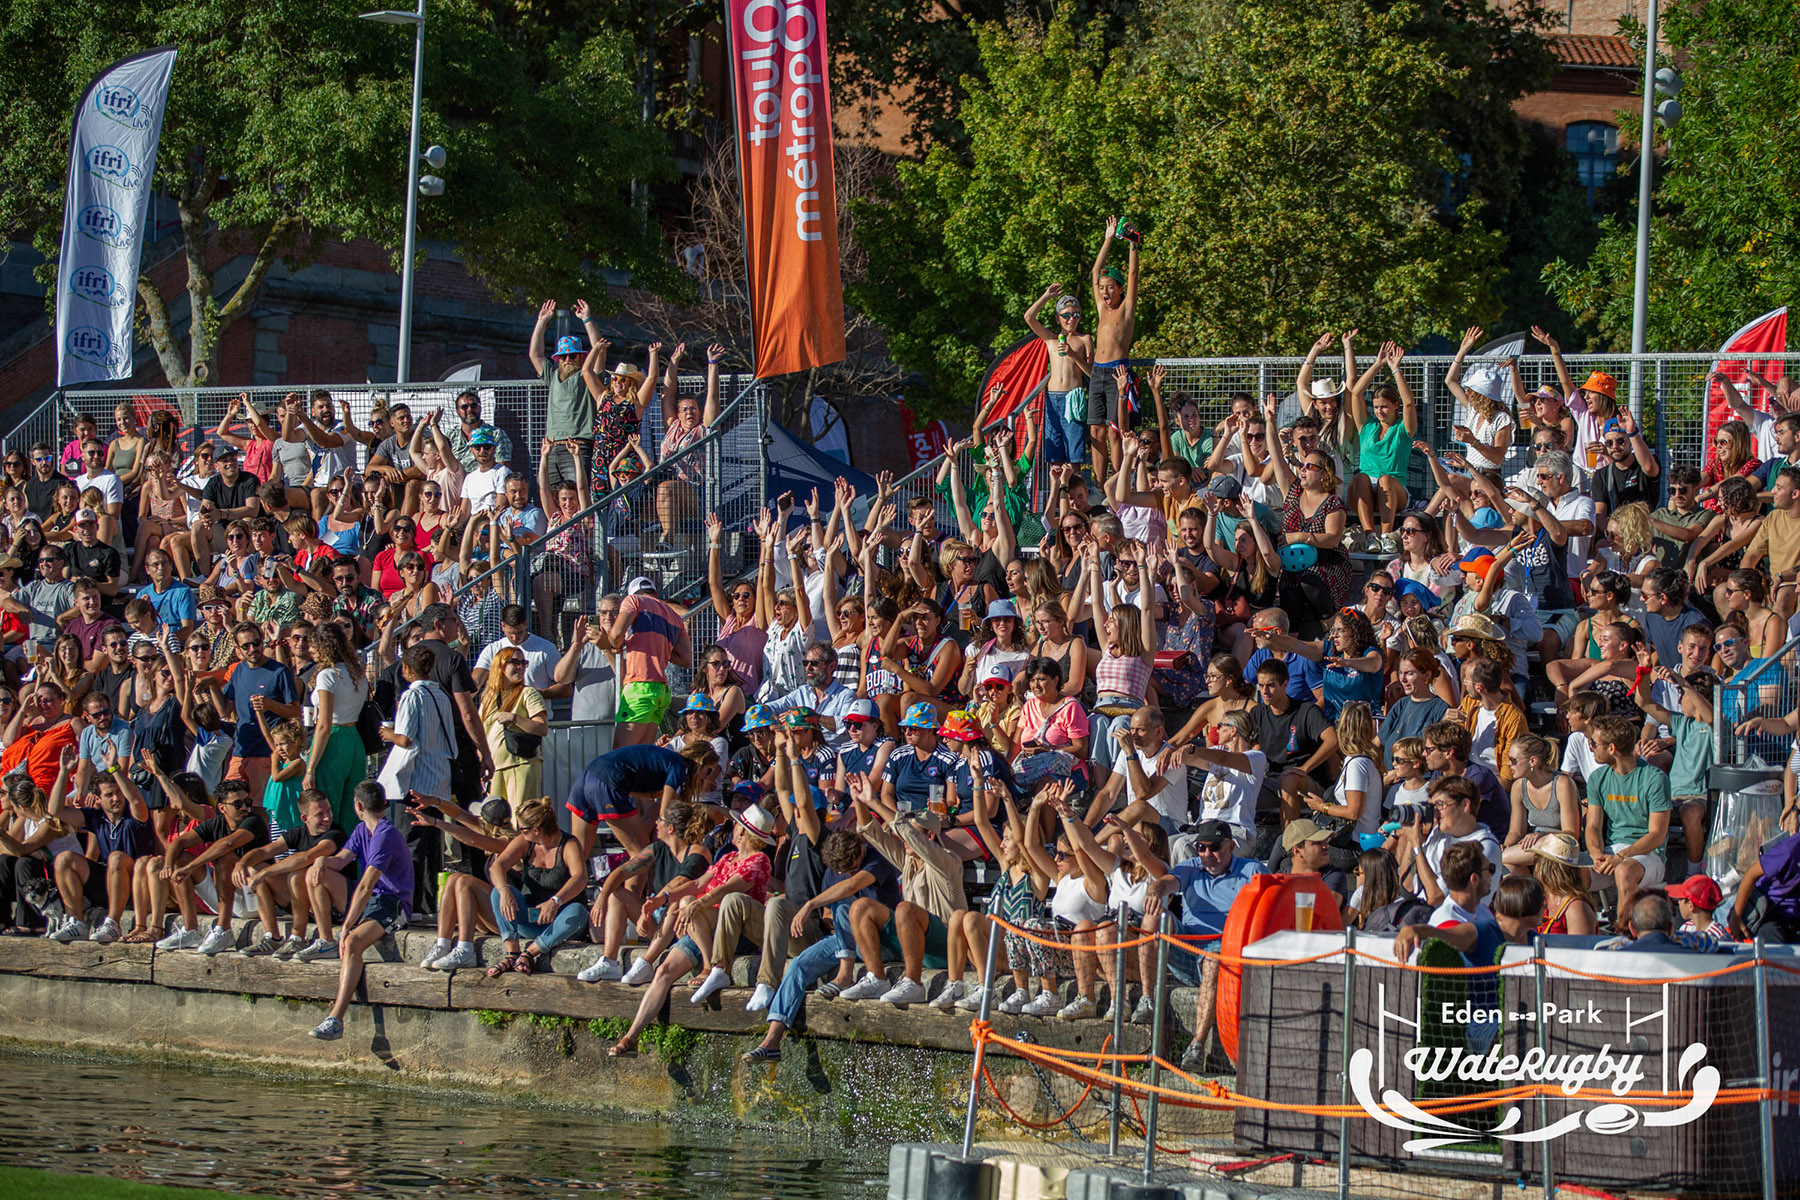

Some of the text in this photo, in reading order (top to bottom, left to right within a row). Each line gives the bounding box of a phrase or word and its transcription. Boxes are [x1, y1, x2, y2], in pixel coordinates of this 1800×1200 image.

[104, 91, 132, 109] ifri
[132, 117, 150, 128] Live
[779, 0, 822, 241] métropo
[94, 150, 122, 169] ifri
[123, 177, 140, 188] Live
[85, 210, 114, 229] ifri
[78, 271, 107, 289] ifri
[73, 332, 102, 349] ifri
